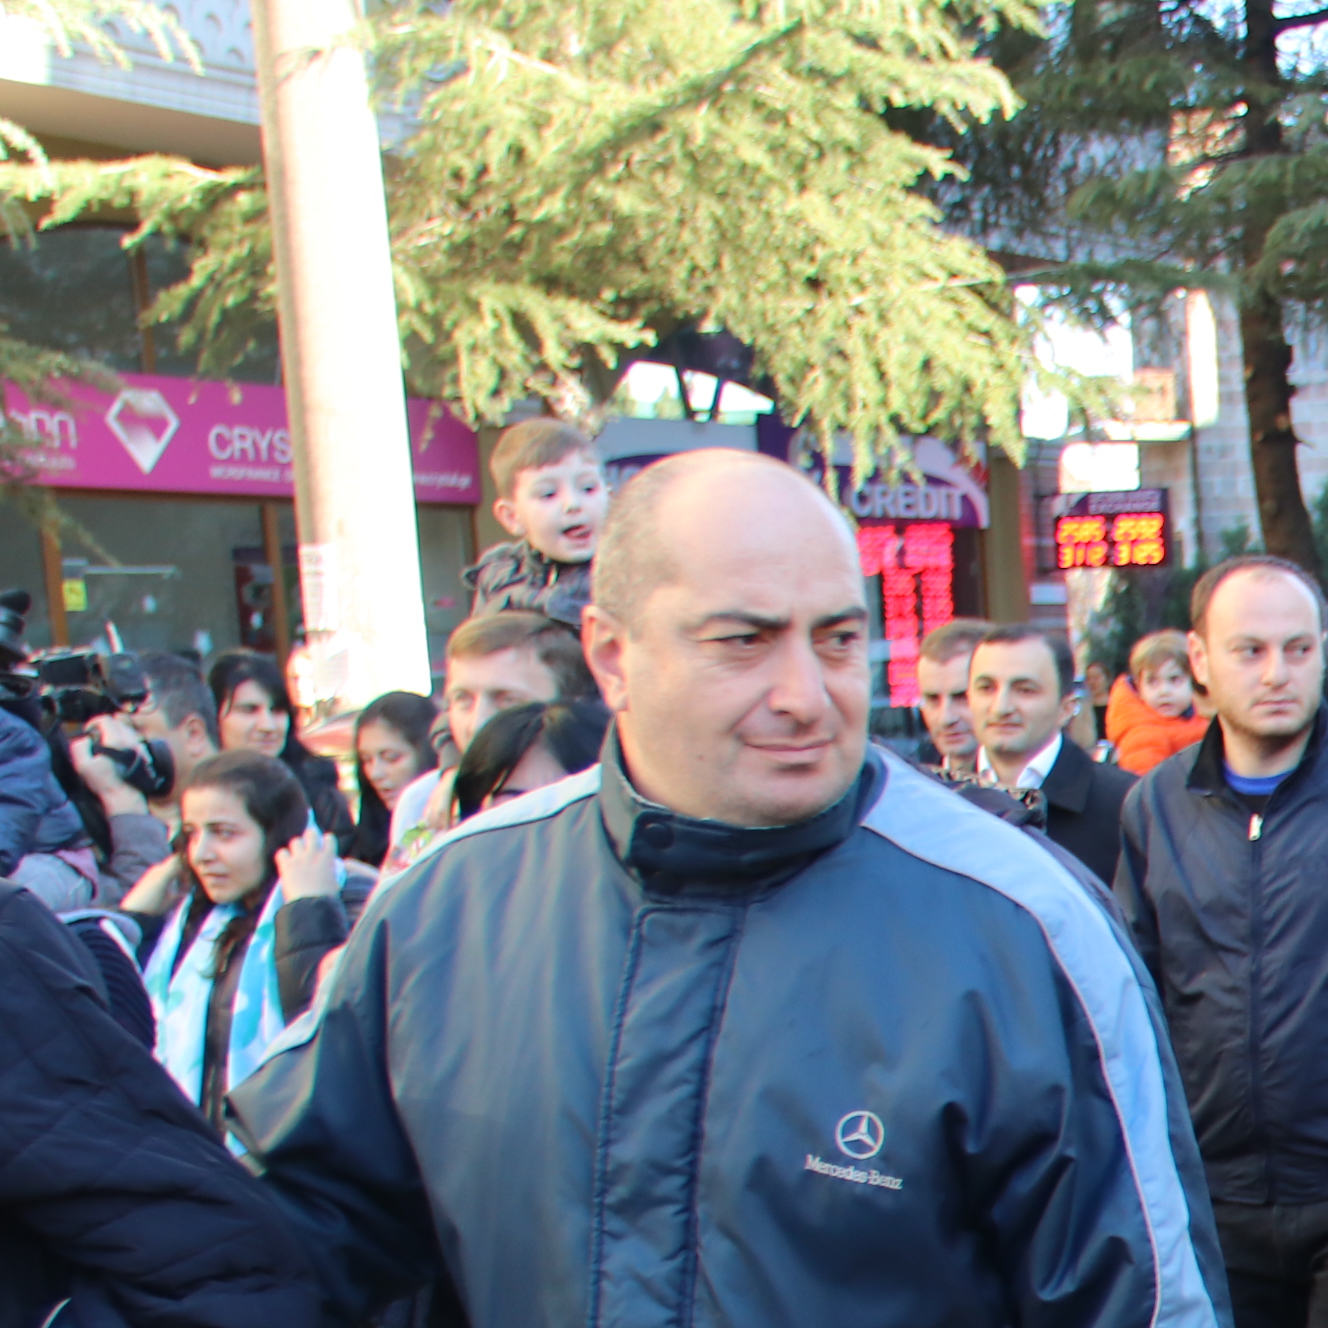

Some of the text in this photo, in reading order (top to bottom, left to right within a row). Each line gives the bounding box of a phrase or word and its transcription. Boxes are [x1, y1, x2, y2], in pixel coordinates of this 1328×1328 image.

[207, 424, 294, 464] CRYS
[850, 482, 963, 521] CREDIT
[803, 1153, 904, 1191] Mercedes-Benz
